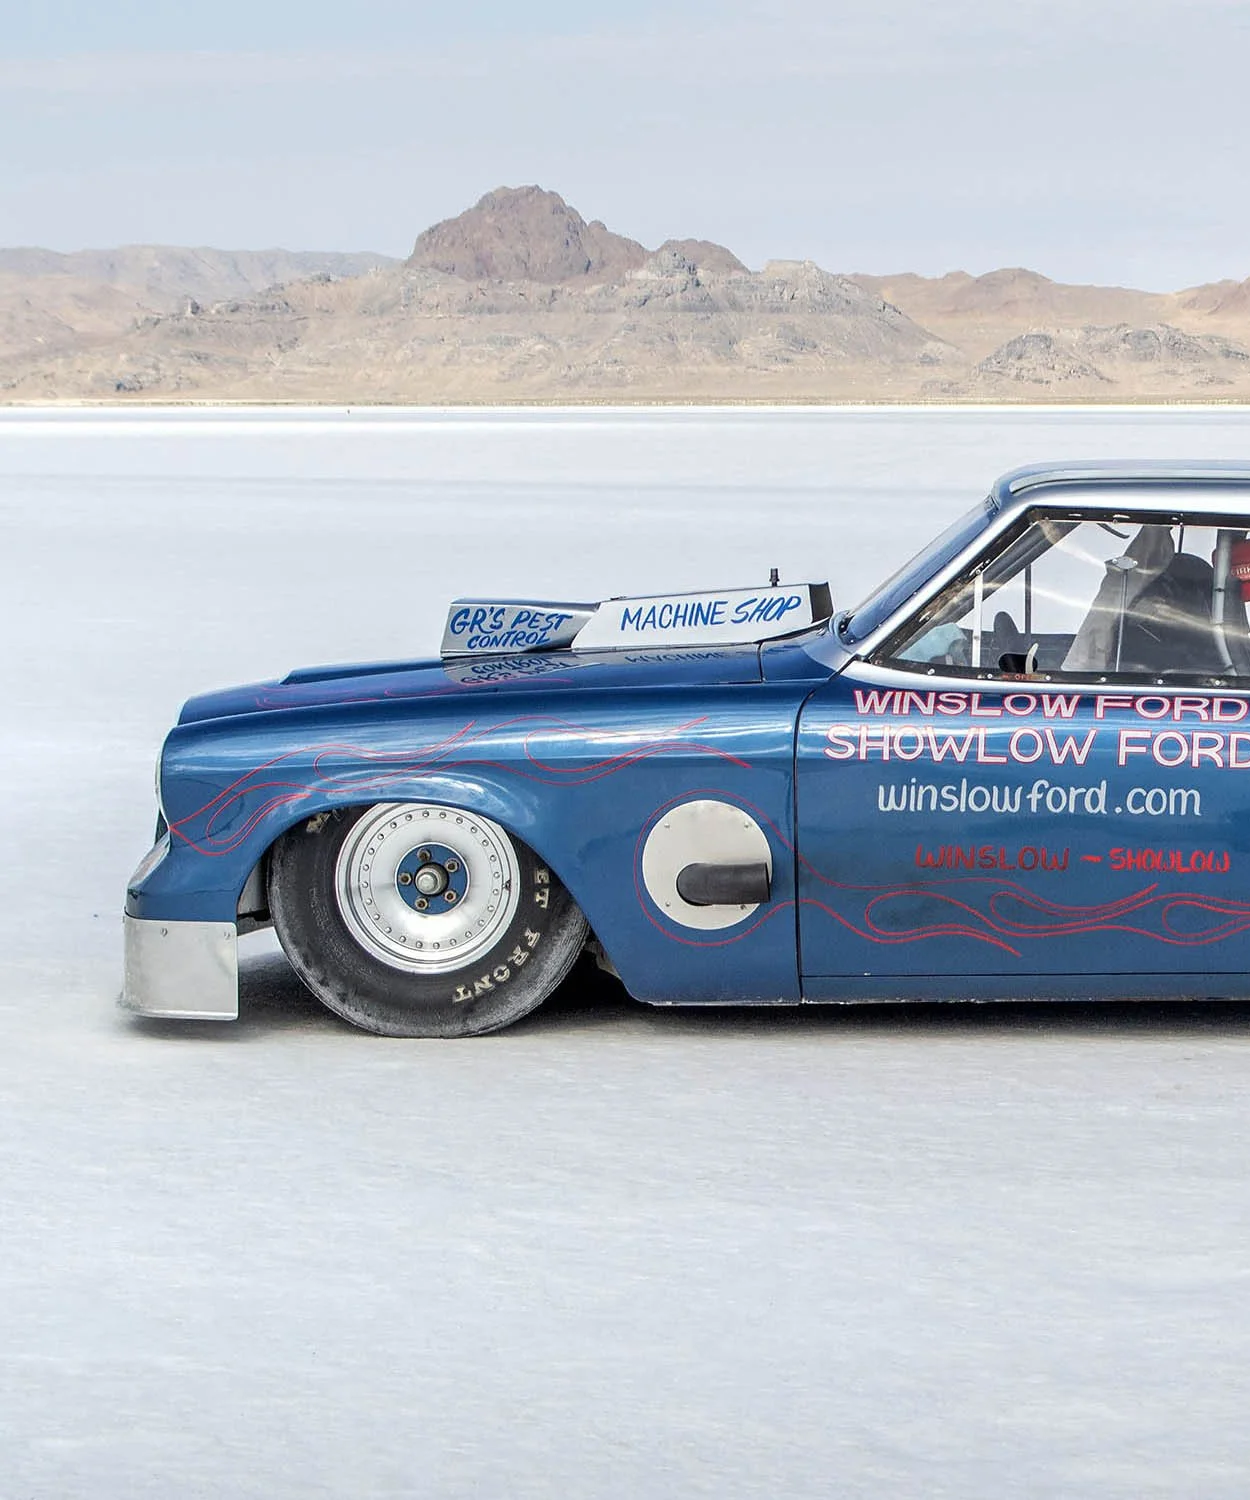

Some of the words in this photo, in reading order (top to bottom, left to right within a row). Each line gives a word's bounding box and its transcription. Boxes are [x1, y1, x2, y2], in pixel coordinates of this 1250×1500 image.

[450, 607, 504, 635] GR'S
[511, 611, 572, 632] PEST
[620, 601, 727, 631] MACHINE
[730, 595, 801, 624] SHOP
[467, 631, 551, 649] CONTROL
[854, 690, 1081, 719] WINSLOW
[1095, 694, 1249, 723] FORD
[824, 725, 1097, 765] SHOWLOW
[878, 778, 1202, 816] winslowford.com
[915, 845, 1070, 871] WINSLOW
[1109, 848, 1230, 873] SHOWLOW
[534, 868, 550, 909] ET
[454, 927, 541, 1003] FRONT
